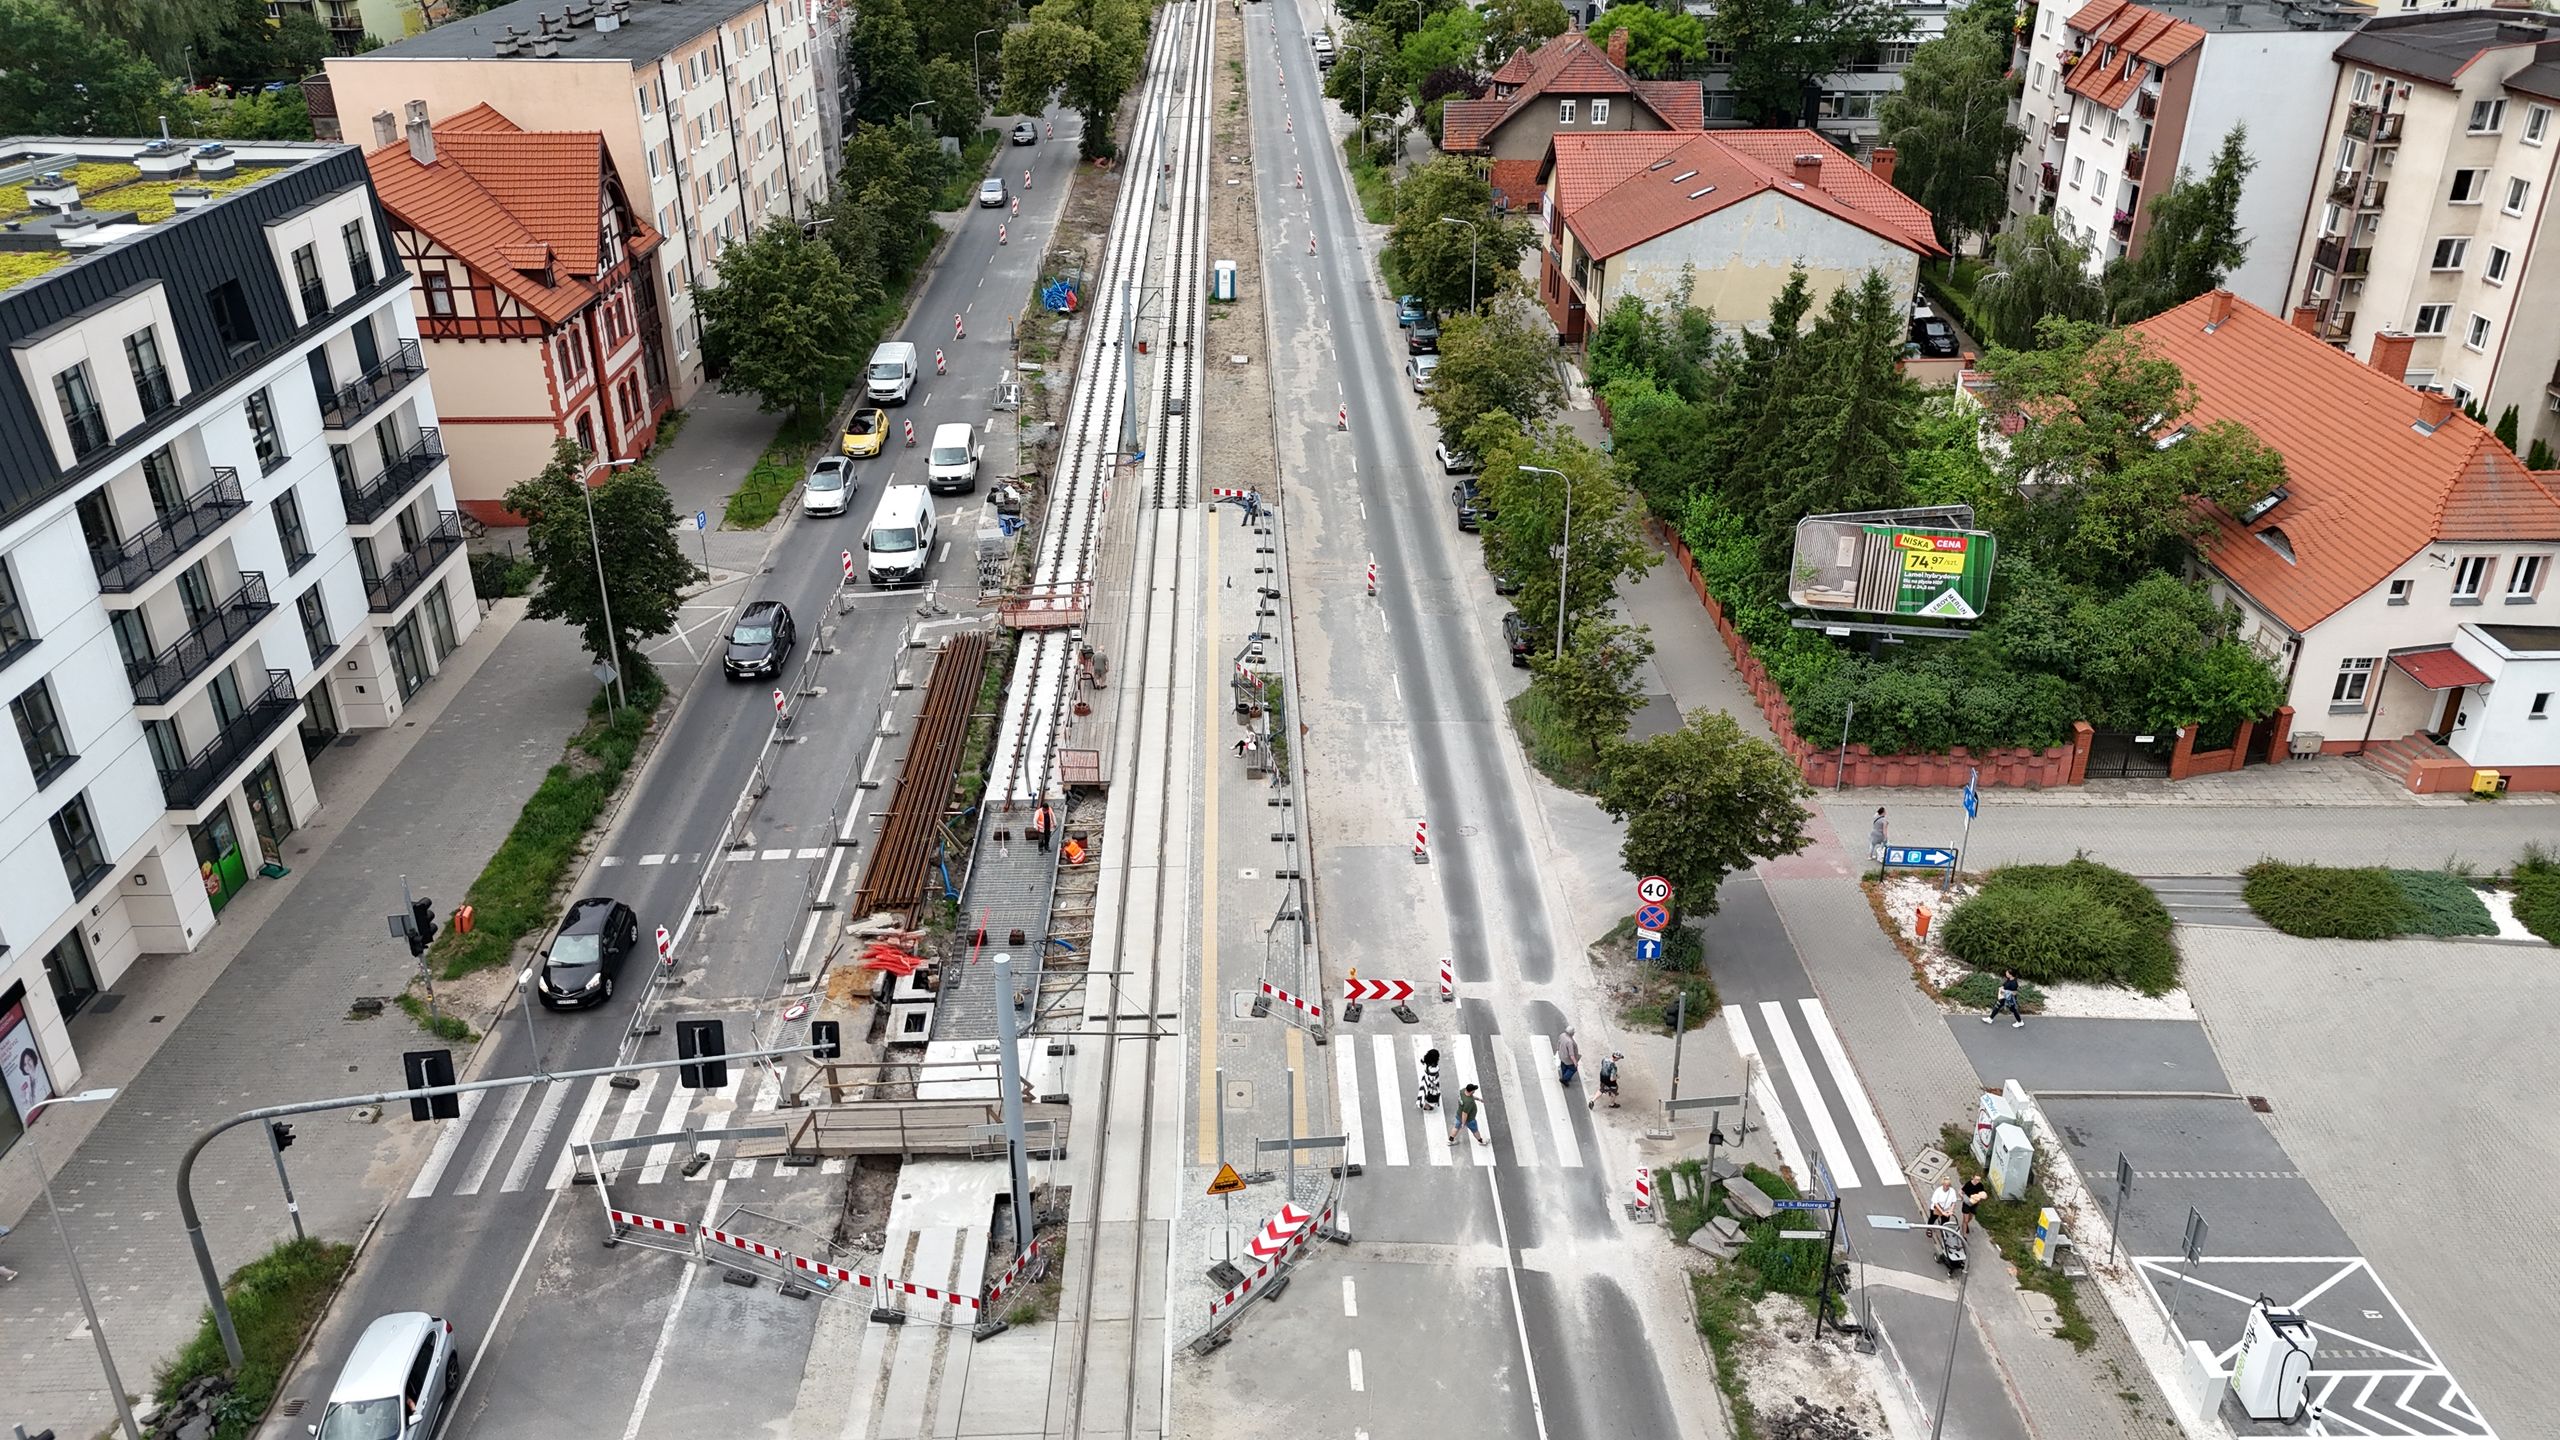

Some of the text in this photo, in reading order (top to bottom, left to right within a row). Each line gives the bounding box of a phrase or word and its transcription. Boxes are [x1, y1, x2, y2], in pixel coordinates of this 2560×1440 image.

[1903, 536, 1961, 549] NISKA CENA
[1925, 572, 1961, 581] hybrydowy
[1930, 594, 1967, 615] LEROY MERLIN
[1643, 884, 1667, 897] 40
[2233, 1323, 2257, 1391] greenway
